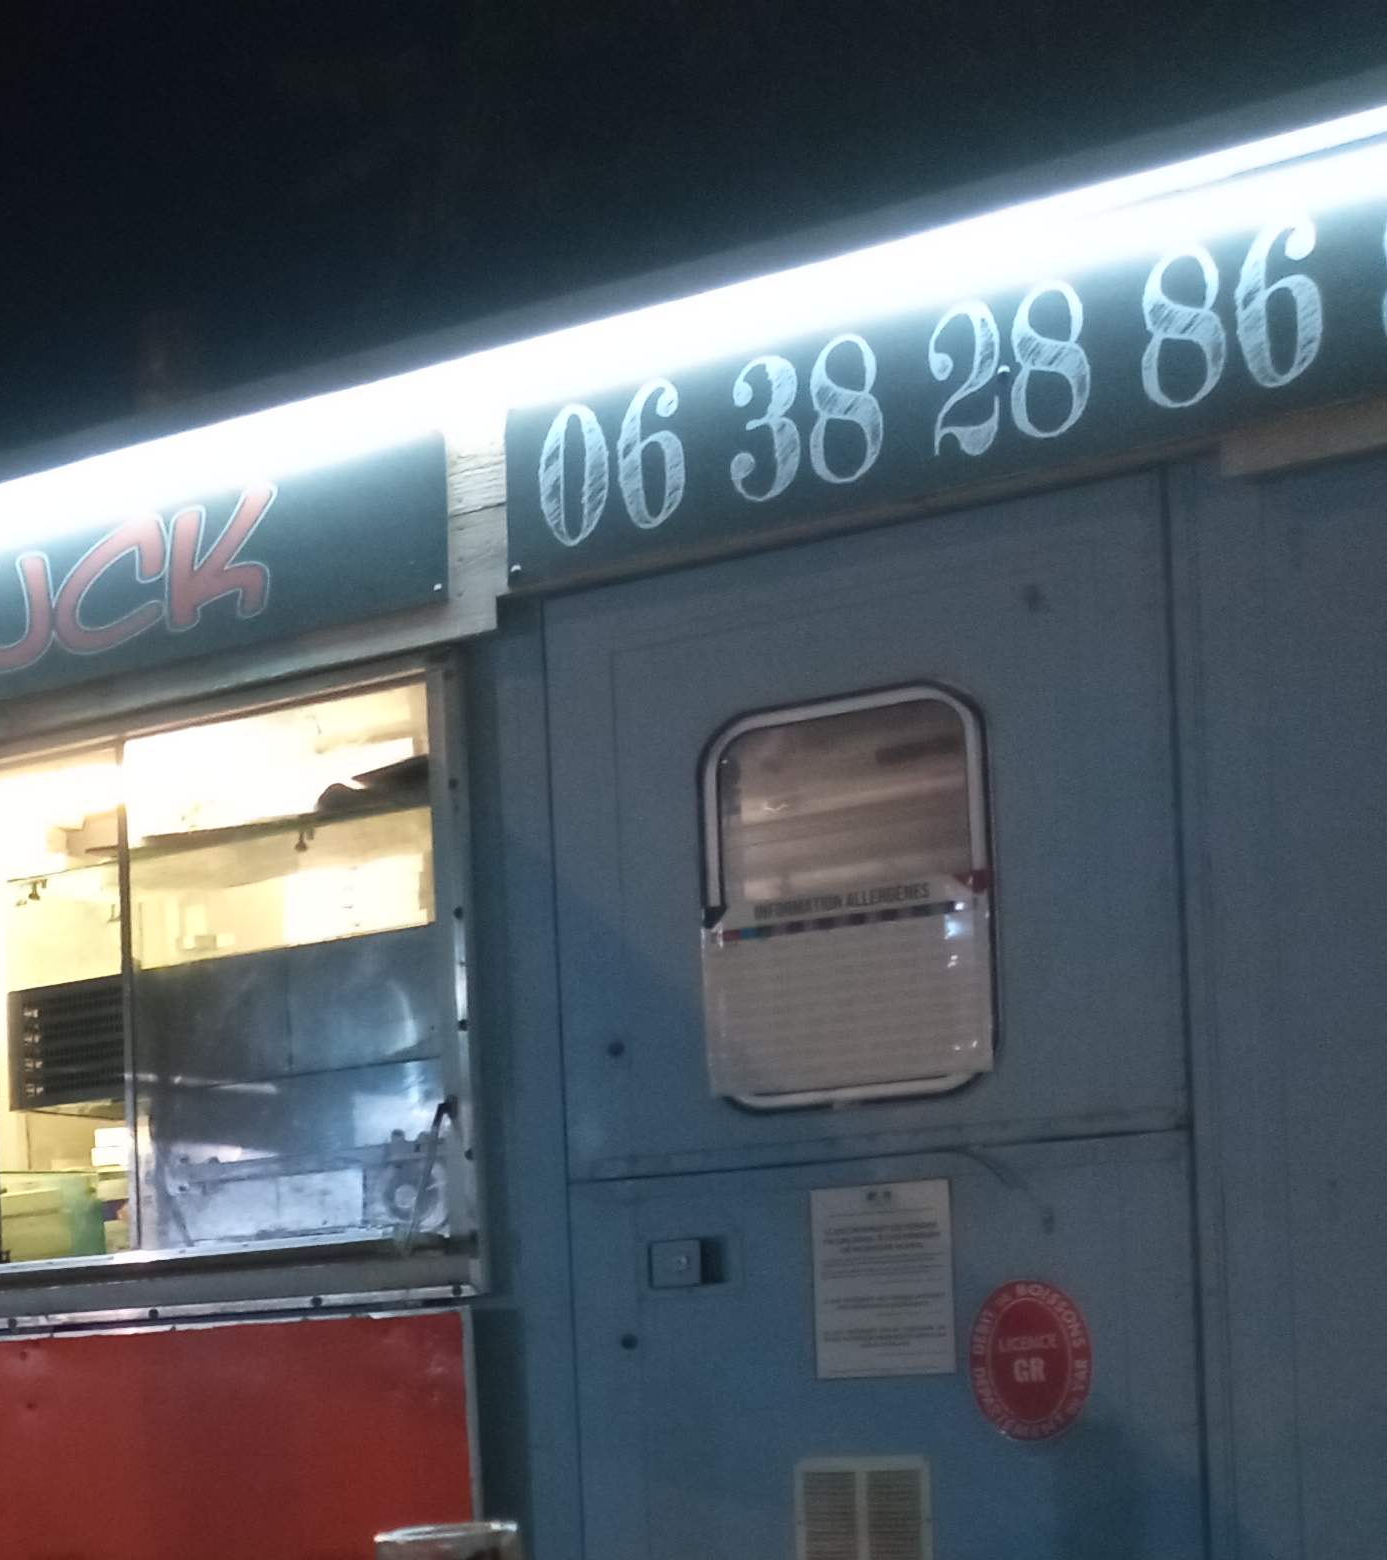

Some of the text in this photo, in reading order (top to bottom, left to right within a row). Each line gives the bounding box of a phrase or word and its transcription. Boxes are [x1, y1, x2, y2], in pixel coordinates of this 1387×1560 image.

[538, 377, 686, 547] 06
[729, 332, 883, 503] 38
[928, 278, 1092, 457] 28
[1139, 213, 1324, 409] 86
[1013, 1356, 1047, 1383] GR
